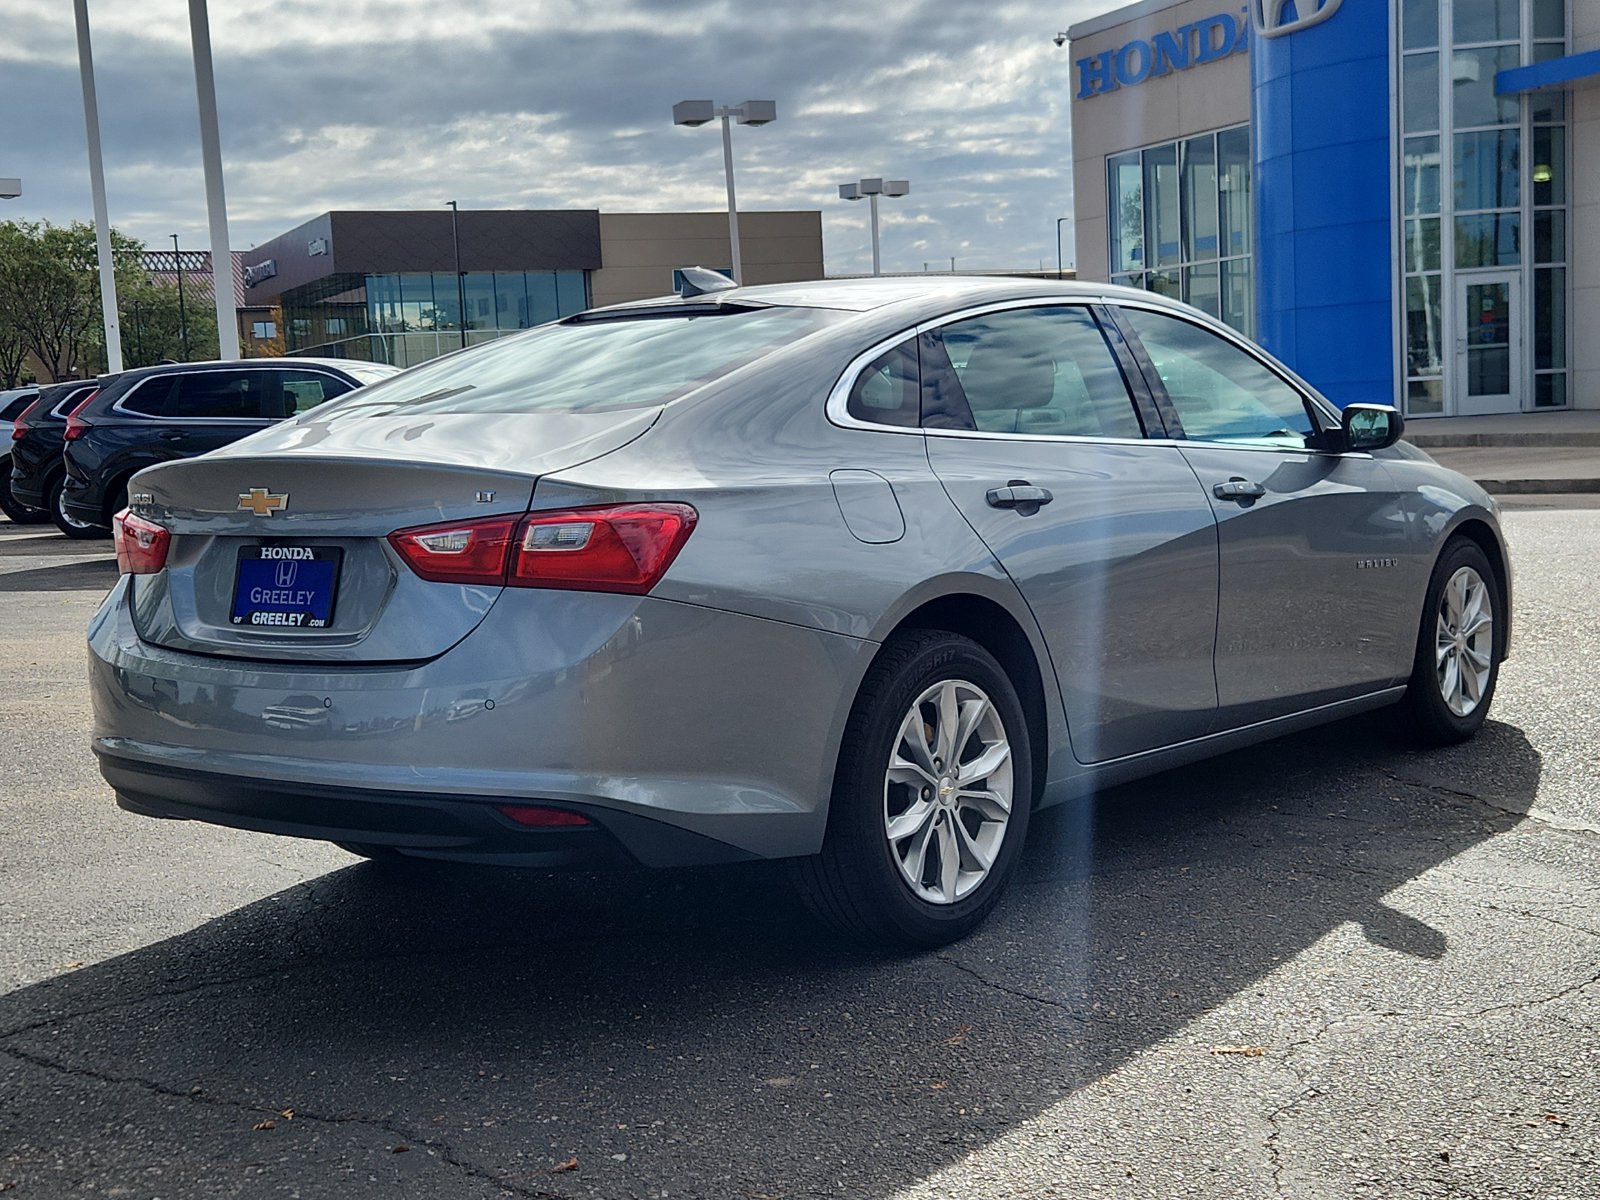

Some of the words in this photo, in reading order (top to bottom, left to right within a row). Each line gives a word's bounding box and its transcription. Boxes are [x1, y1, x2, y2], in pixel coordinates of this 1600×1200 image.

[475, 491, 496, 503] LT
[260, 547, 315, 560] HONDA
[1357, 558, 1399, 569] MALIBU
[250, 587, 315, 606] GREELEY
[233, 616, 243, 624] OF
[251, 612, 305, 626] GREELEY
[308, 619, 325, 627] .COM
